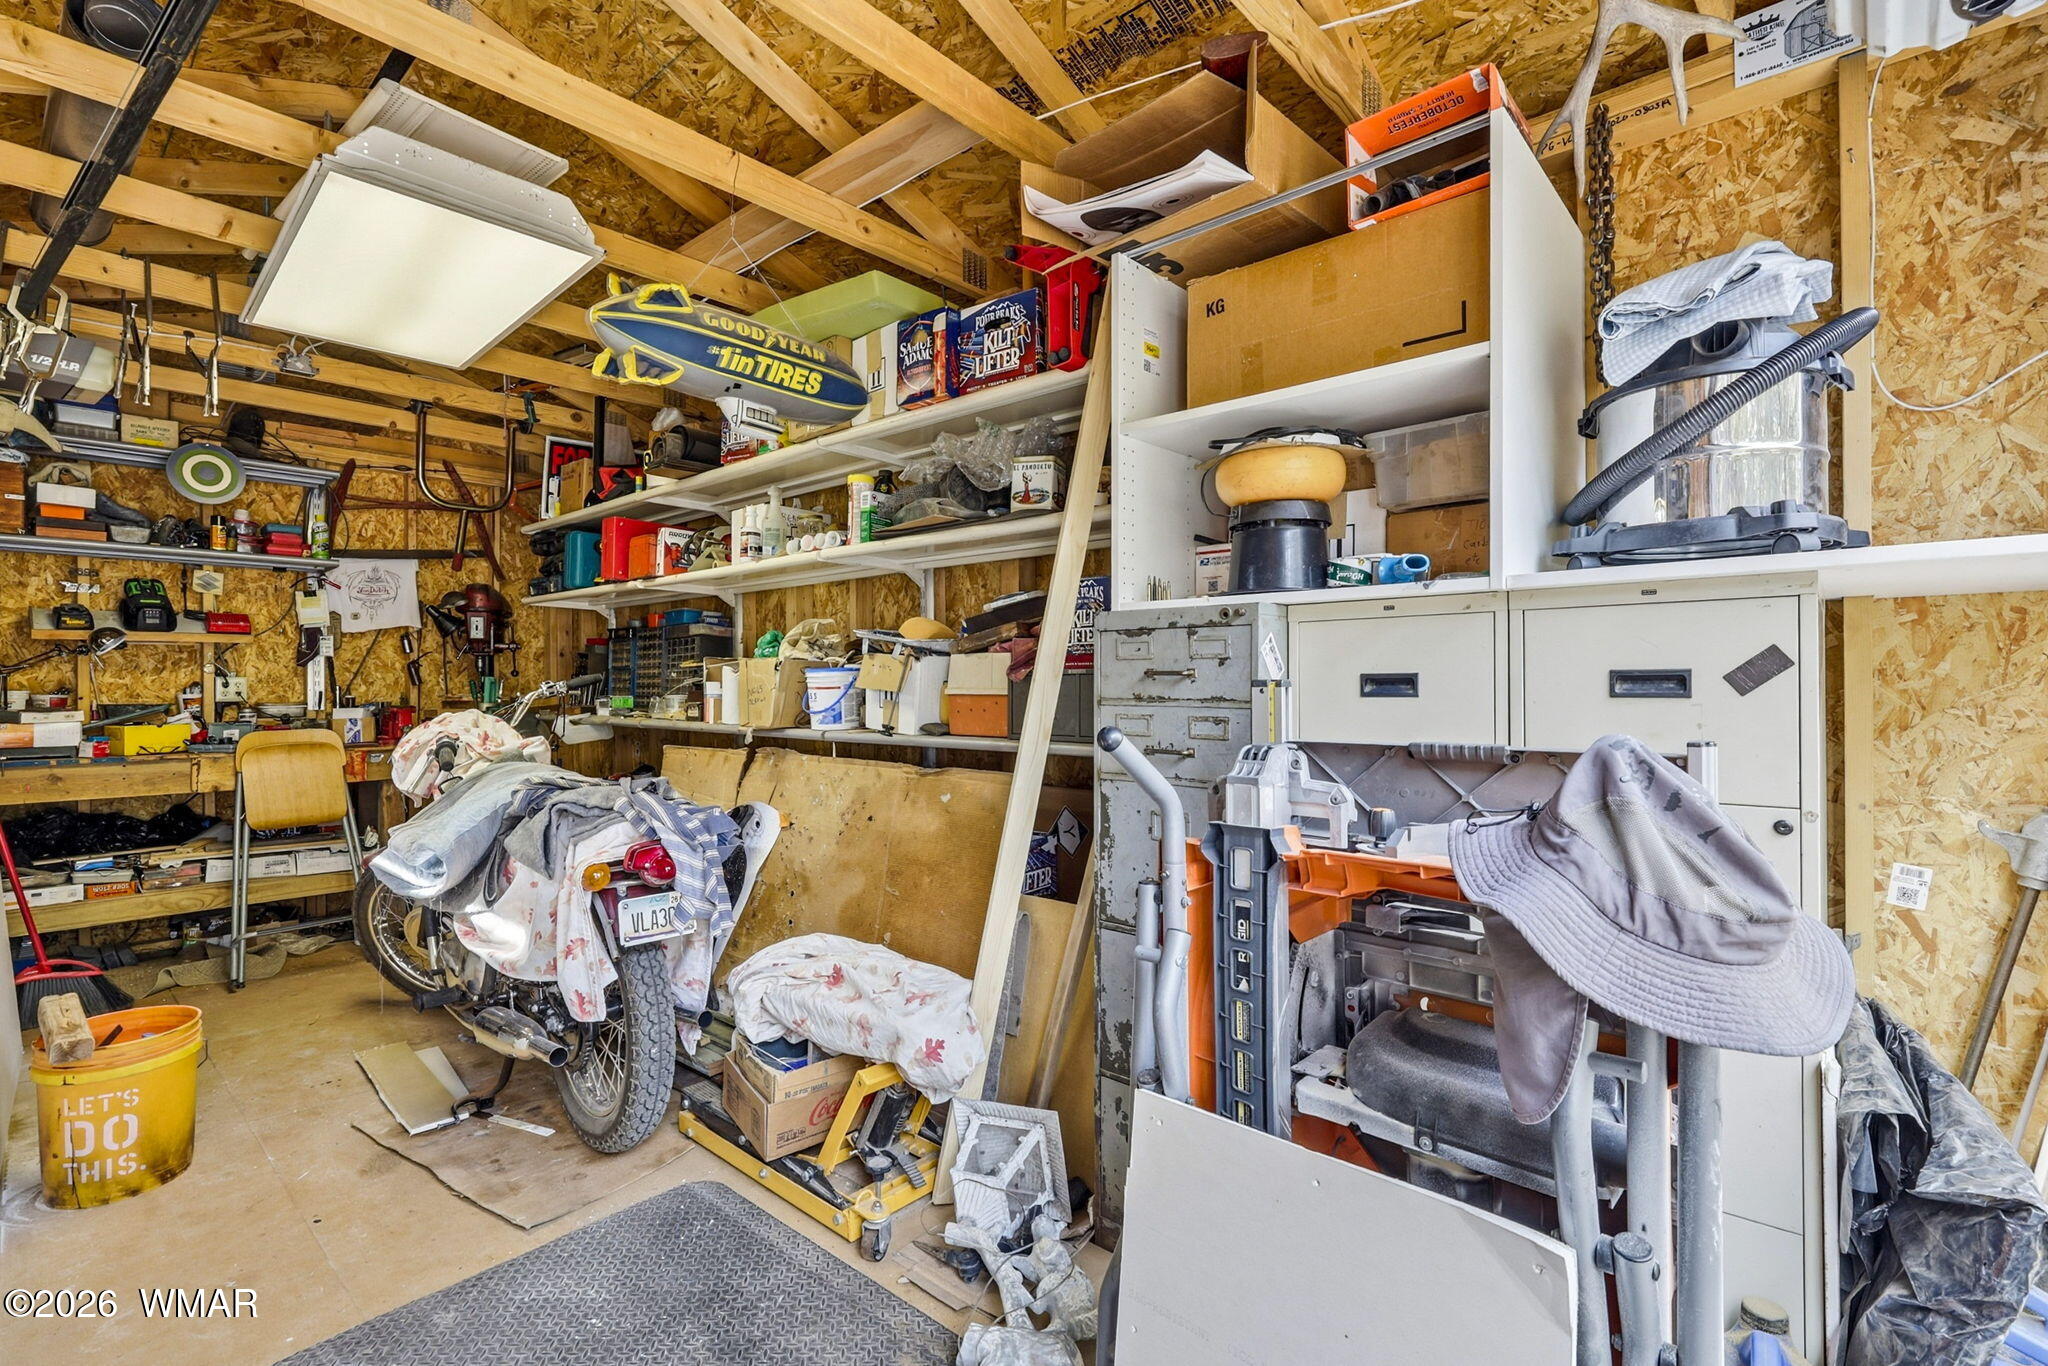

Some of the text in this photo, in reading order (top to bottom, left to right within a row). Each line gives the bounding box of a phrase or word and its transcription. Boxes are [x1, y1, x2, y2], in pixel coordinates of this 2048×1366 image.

[1386, 95, 1465, 136] OCTOBERFEST
[995, 303, 1023, 321] PEAKS
[1206, 298, 1225, 318] KG
[983, 326, 1016, 355] KILT
[29, 353, 52, 366] 1/2
[974, 347, 1021, 380] LIFTER
[1079, 586, 1104, 601] PEAKS
[1023, 866, 1052, 892] IFTER
[62, 1088, 140, 1118] LET'S
[62, 1113, 140, 1158] DO
[61, 1152, 147, 1186] THIS.
